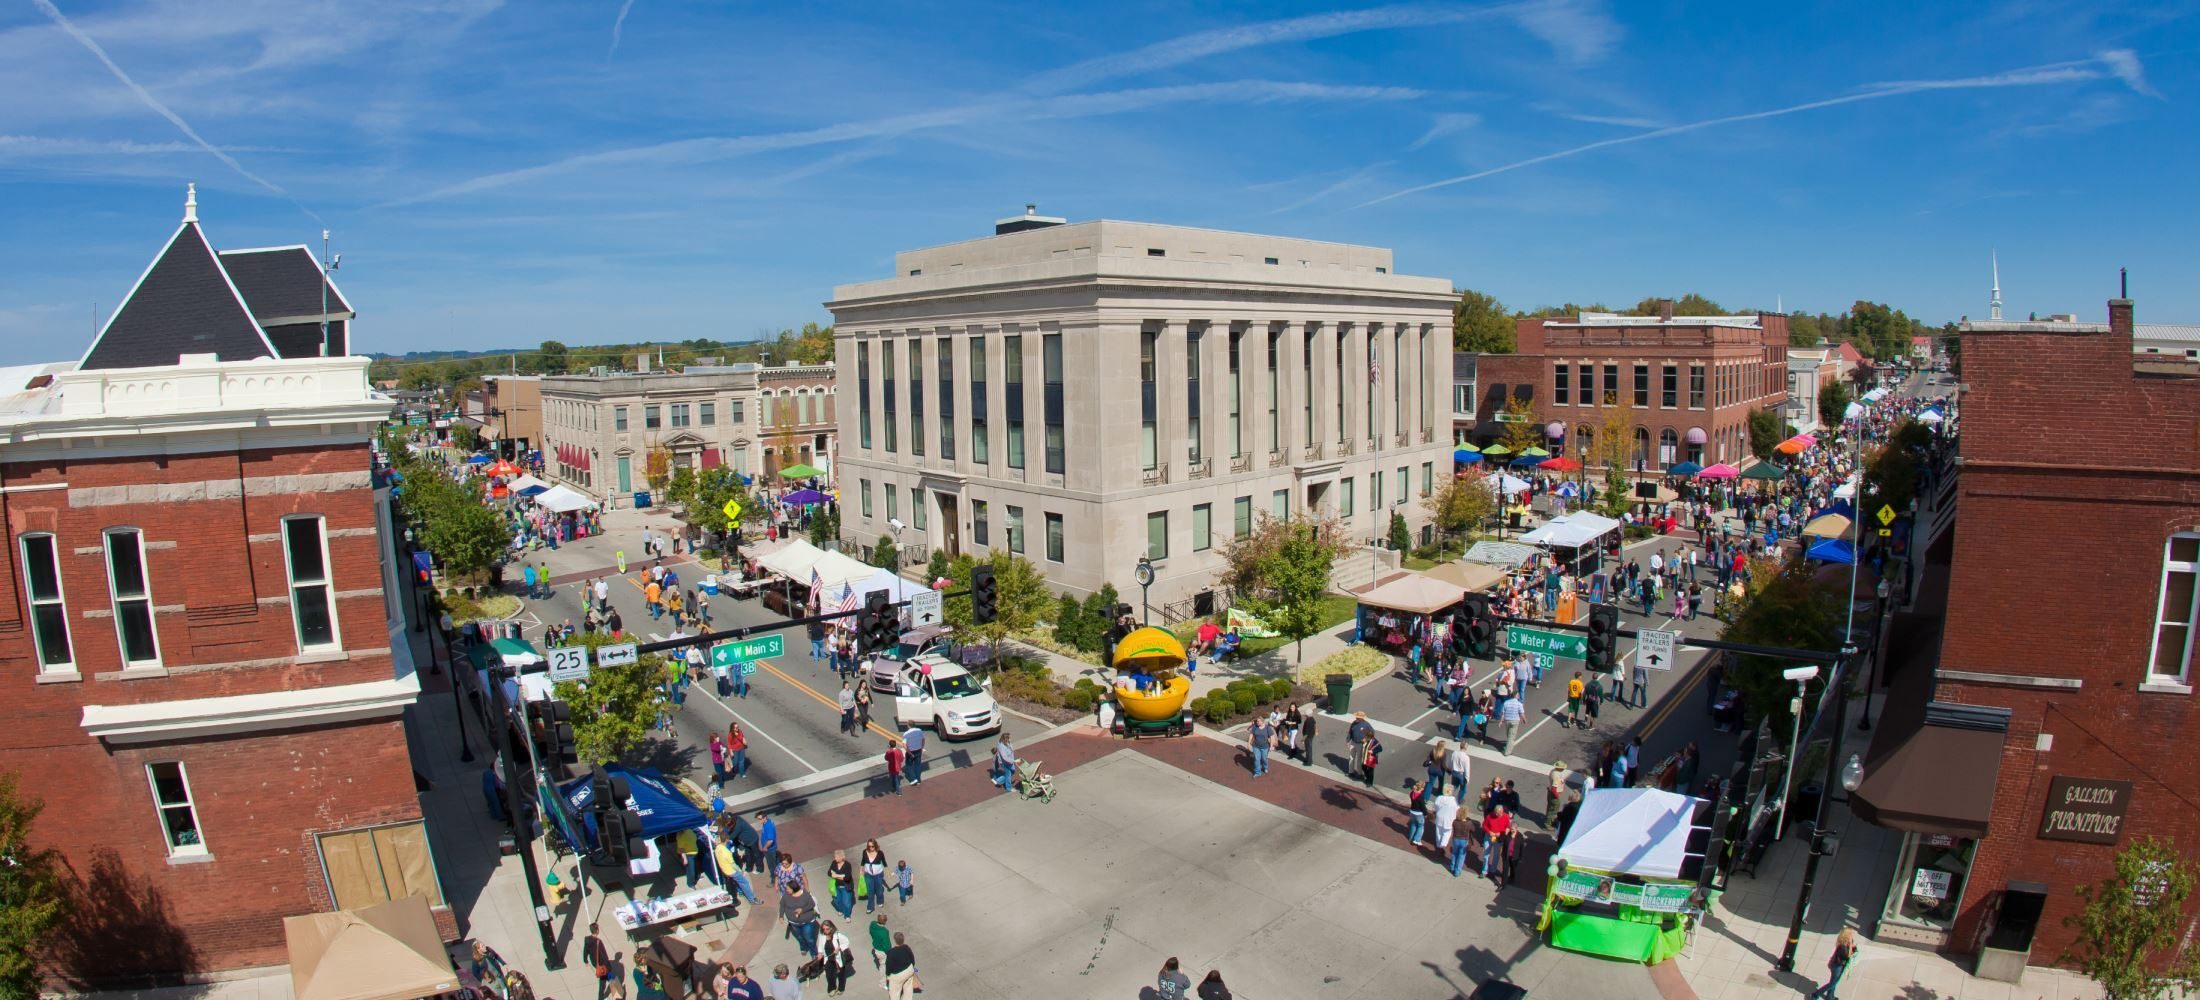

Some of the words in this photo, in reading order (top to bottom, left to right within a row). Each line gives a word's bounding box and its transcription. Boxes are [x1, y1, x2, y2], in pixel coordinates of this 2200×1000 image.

[1510, 631, 1517, 643] S
[1520, 633, 1546, 648] Water
[1548, 637, 1566, 651] Ave
[1642, 637, 1670, 647] TRAILERS
[1643, 631, 1670, 640] TRACTOR
[600, 652, 607, 661] W
[629, 648, 635, 657] E
[733, 646, 742, 658] W
[744, 643, 767, 657] Main
[769, 640, 779, 653] St
[555, 650, 580, 670] 25
[1540, 654, 1554, 668] 3C
[742, 661, 755, 674] 3B
[2064, 785, 2117, 804] GALLATIN
[2045, 810, 2120, 834] FURNITURE
[1931, 871, 1944, 880] OFF
